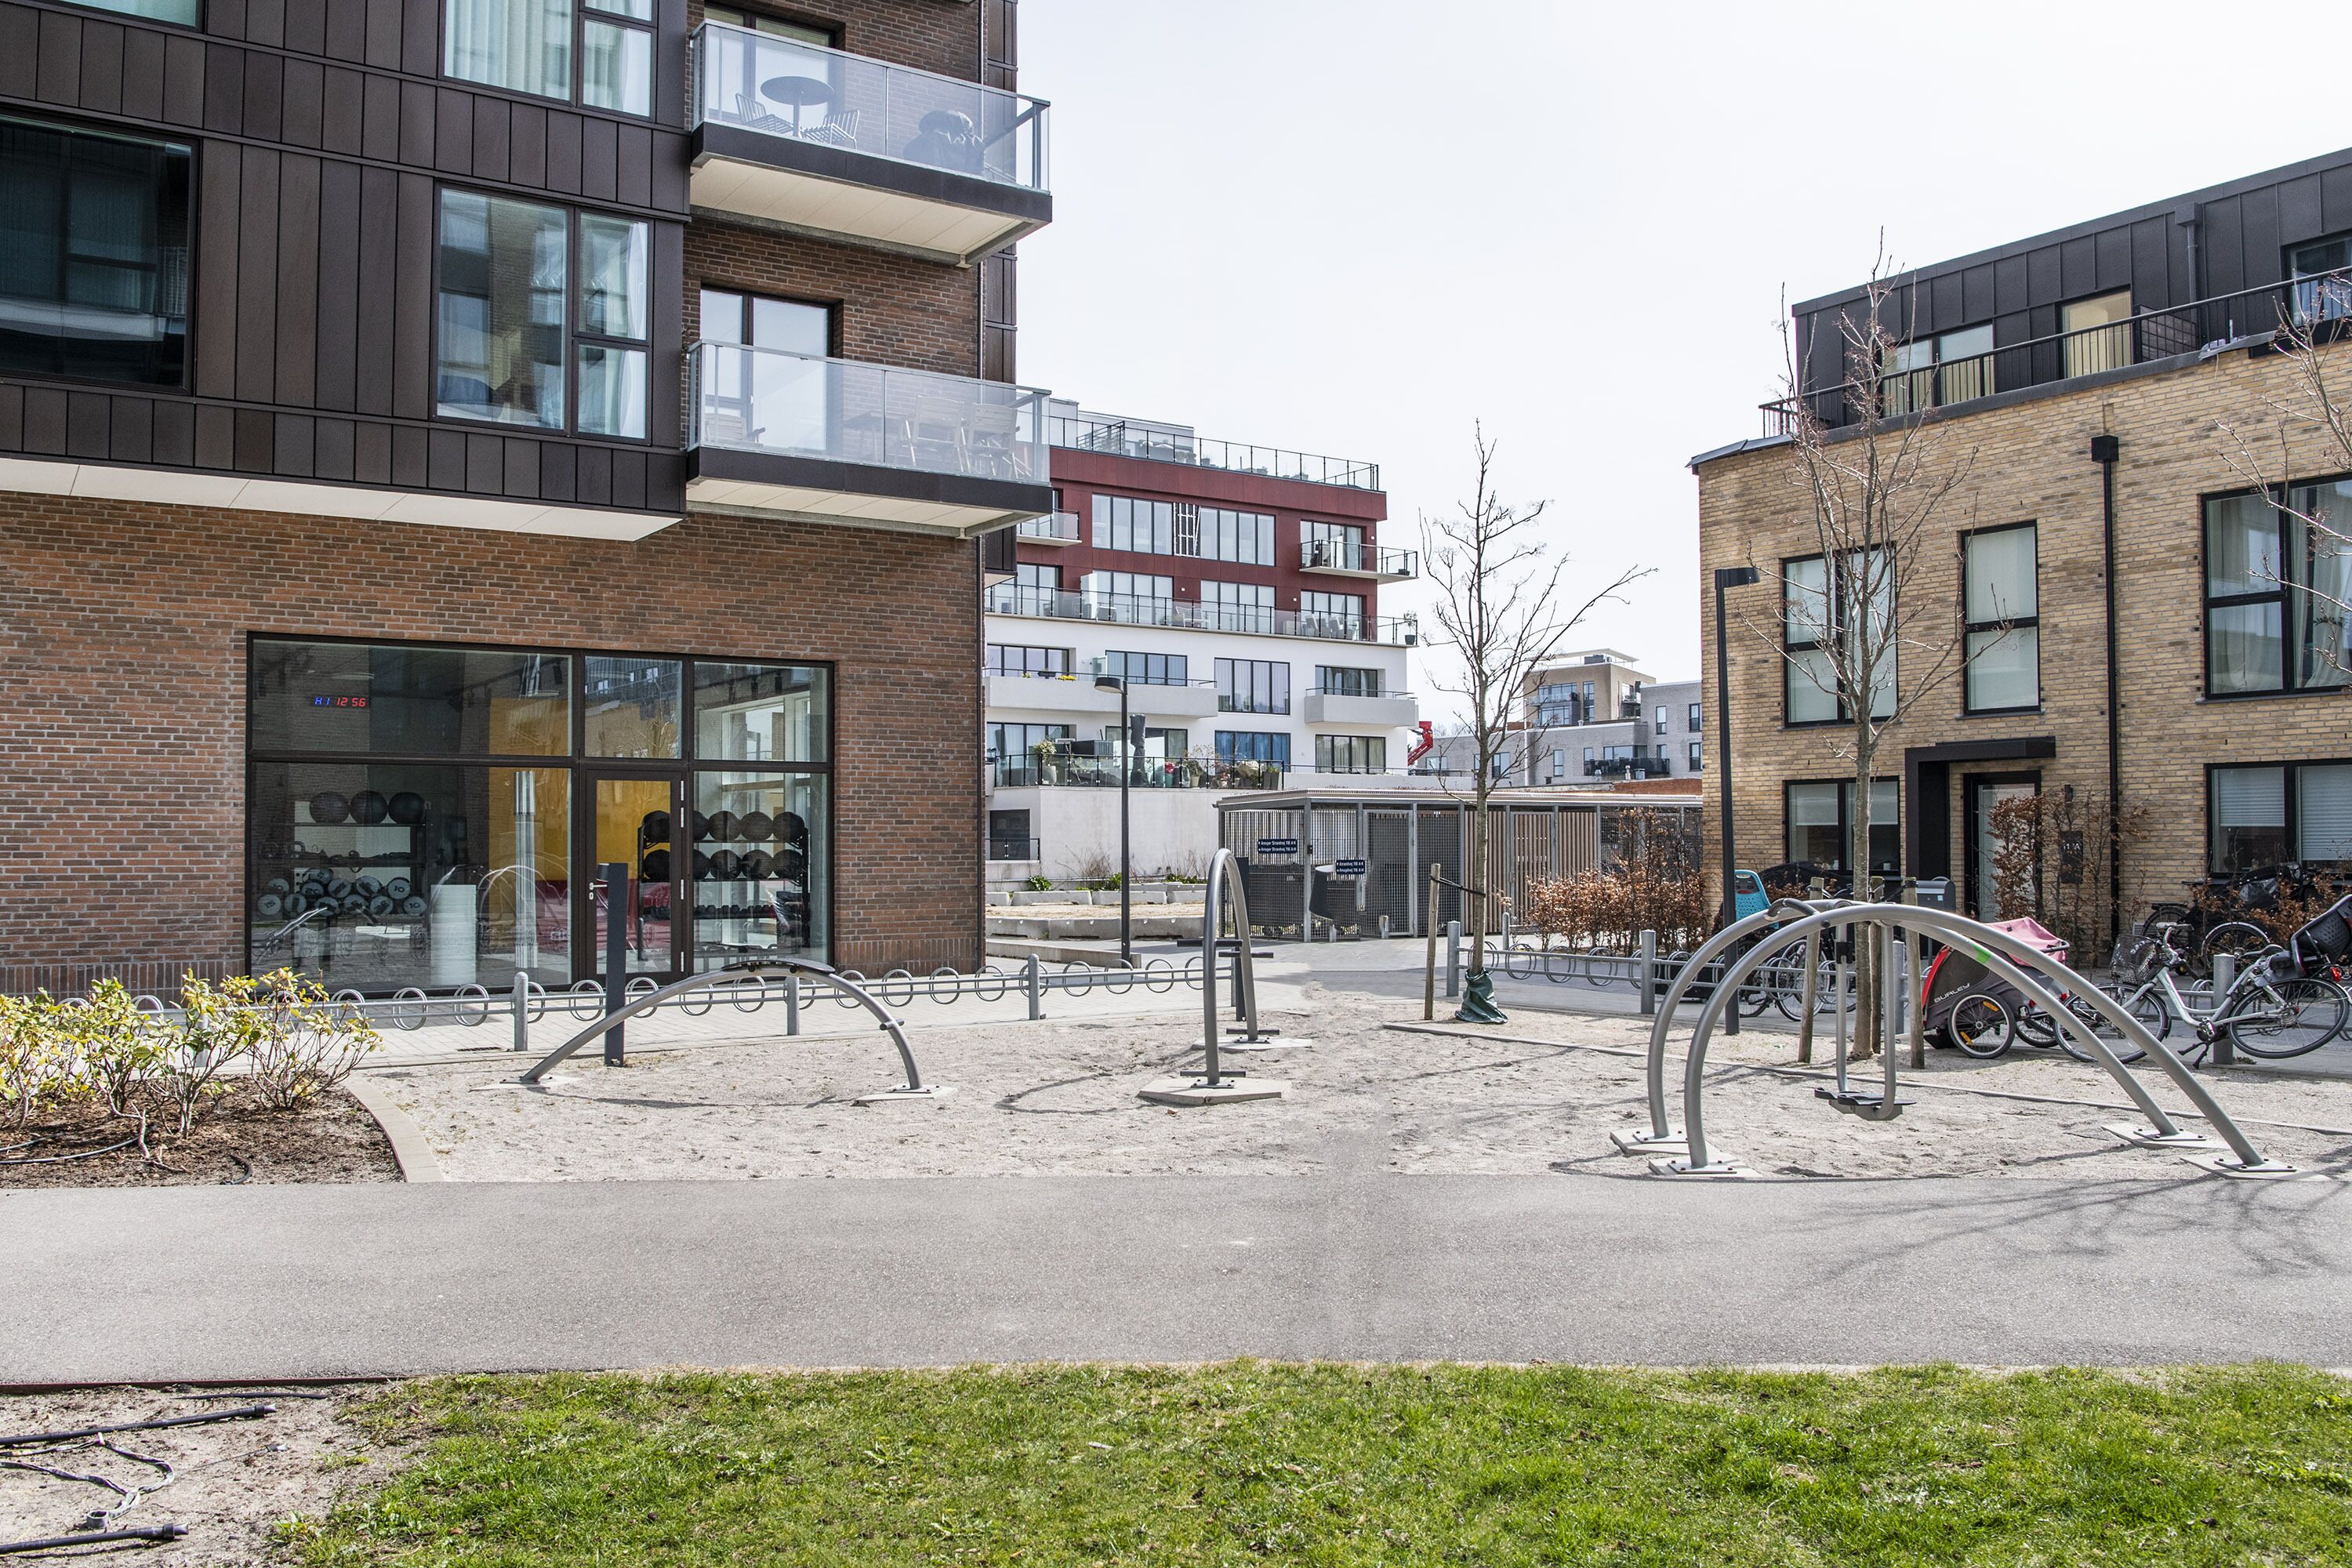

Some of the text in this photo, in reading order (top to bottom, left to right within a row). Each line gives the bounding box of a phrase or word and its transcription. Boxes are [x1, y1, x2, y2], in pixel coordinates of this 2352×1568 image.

[336, 697, 348, 706] 12
[351, 697, 366, 707] 56
[1933, 982, 1970, 1004] BURLEY
